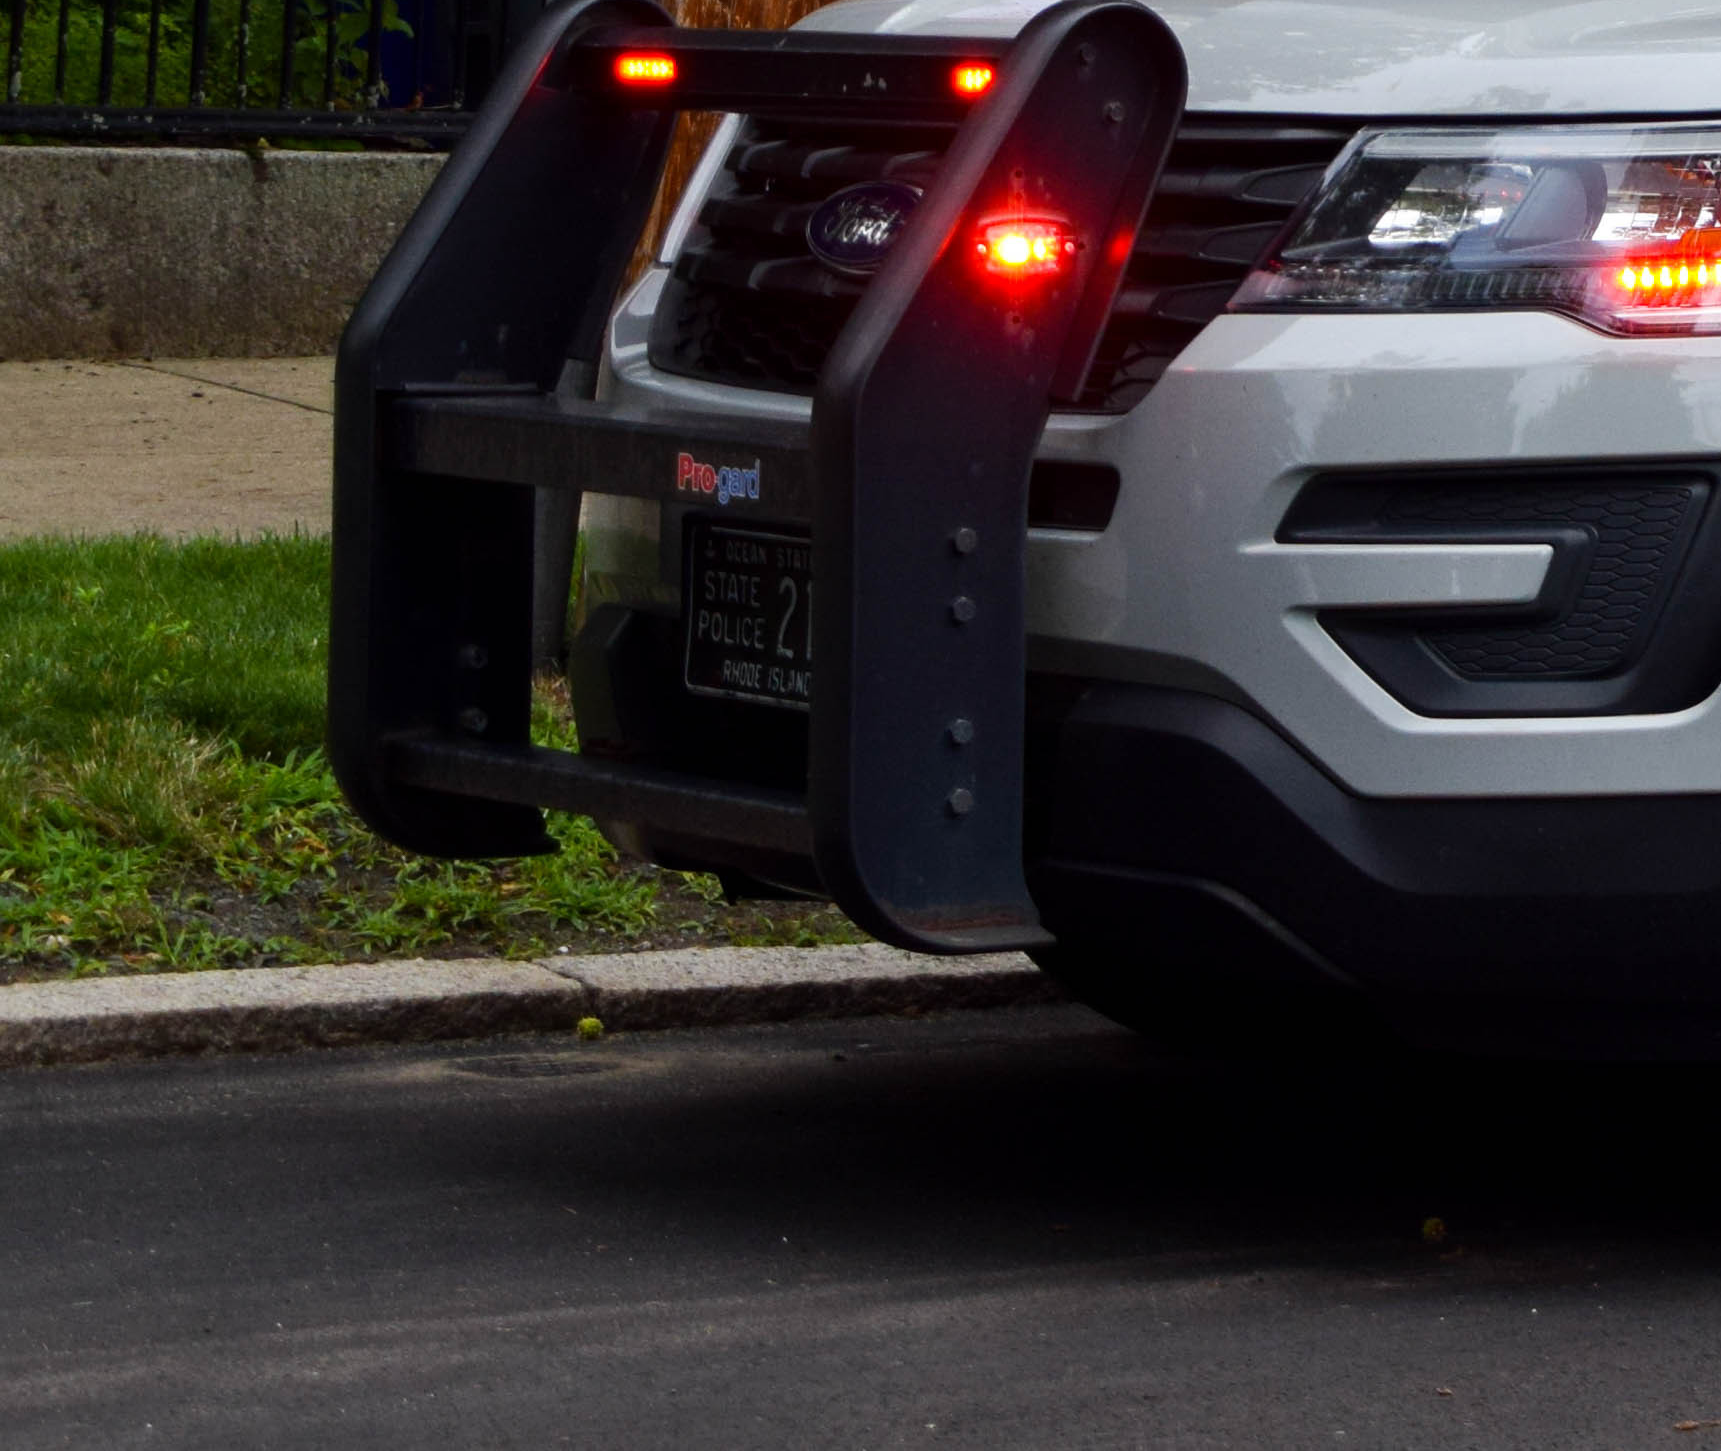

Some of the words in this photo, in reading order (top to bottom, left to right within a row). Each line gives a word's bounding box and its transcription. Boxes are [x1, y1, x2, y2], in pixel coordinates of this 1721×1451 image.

[824, 196, 905, 246] Ford
[705, 571, 761, 608] STATE
[698, 609, 765, 650] POLICE
[723, 659, 762, 689] RHODE
